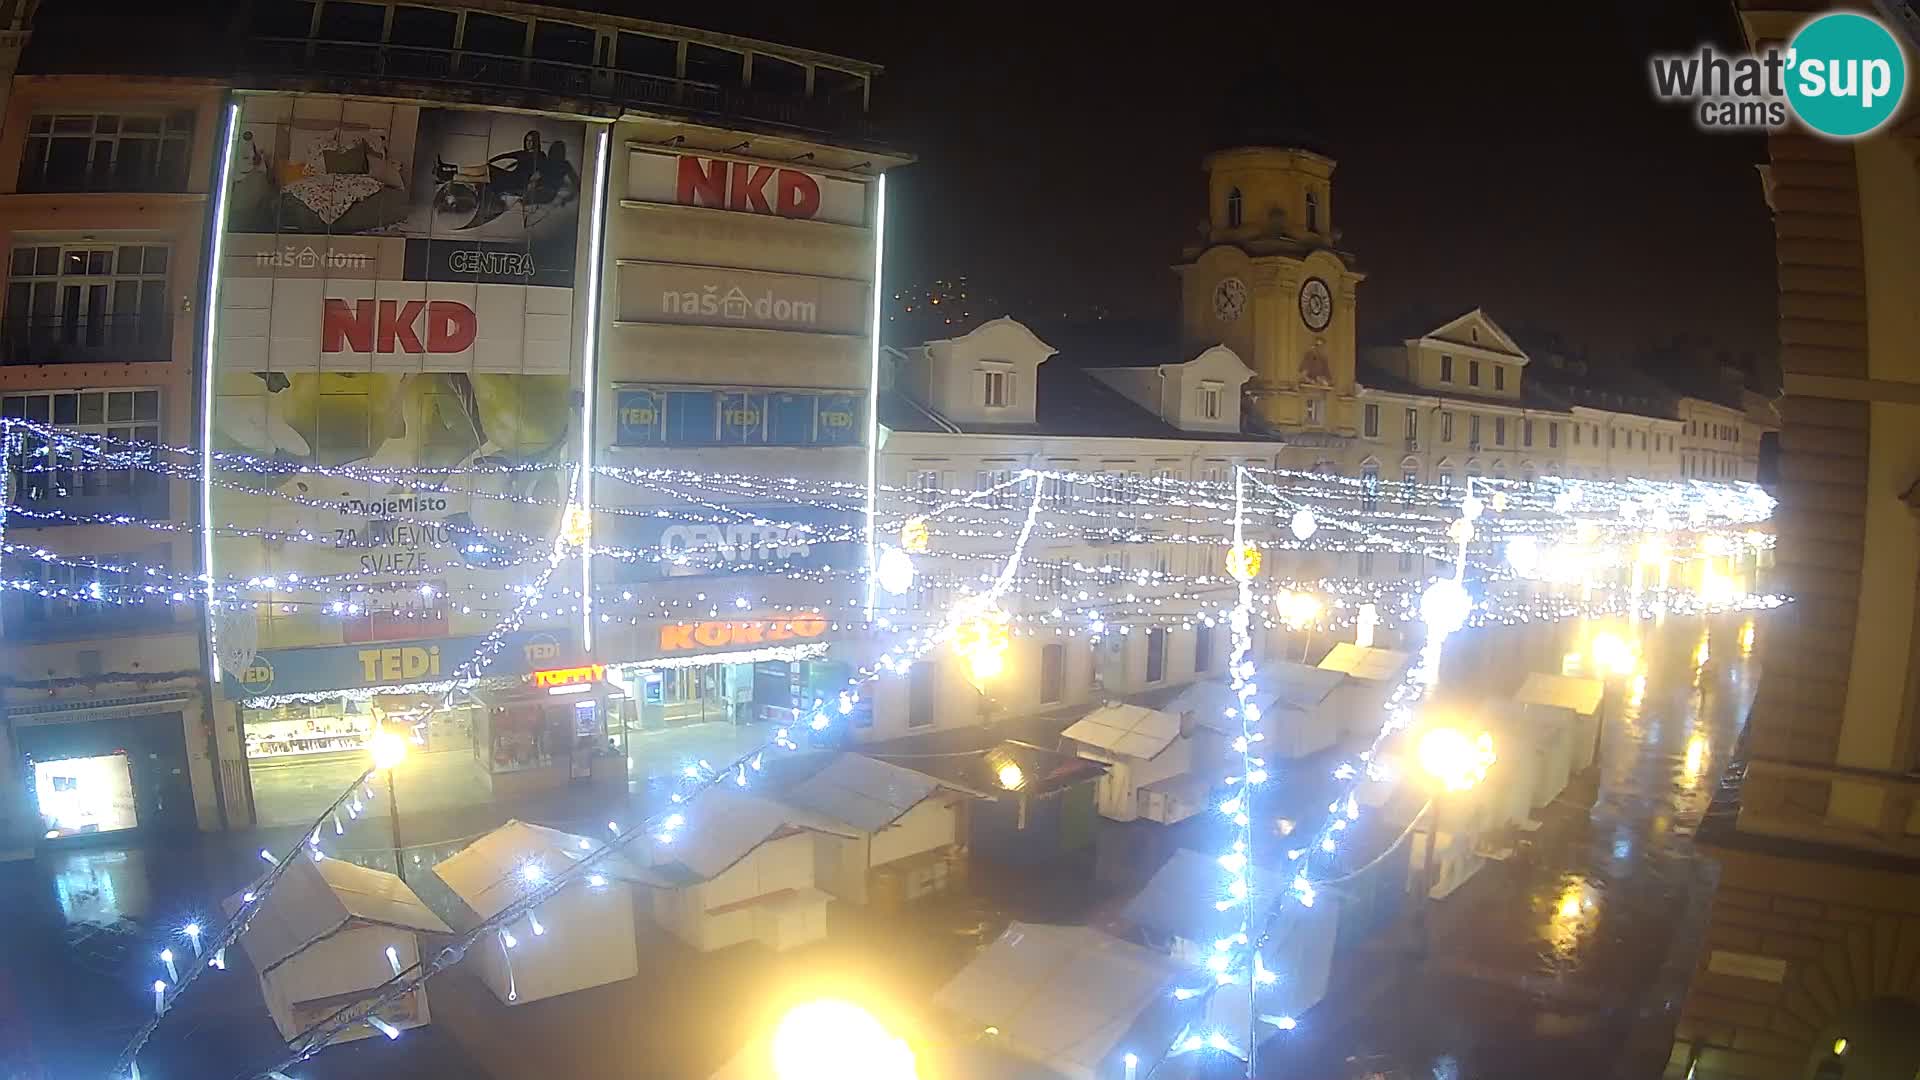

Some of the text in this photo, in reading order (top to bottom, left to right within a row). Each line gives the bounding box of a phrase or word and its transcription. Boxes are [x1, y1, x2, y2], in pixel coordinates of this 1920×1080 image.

[676, 154, 821, 220] NKD
[256, 245, 368, 271] naš dom
[448, 250, 536, 276] CENTRA
[662, 284, 816, 323] naš dom
[321, 297, 478, 353] NKD
[339, 498, 446, 516] #TvojeMisto
[660, 524, 811, 563] CENTRA
[660, 612, 827, 650] KORZO
[359, 646, 441, 682] TEDi
